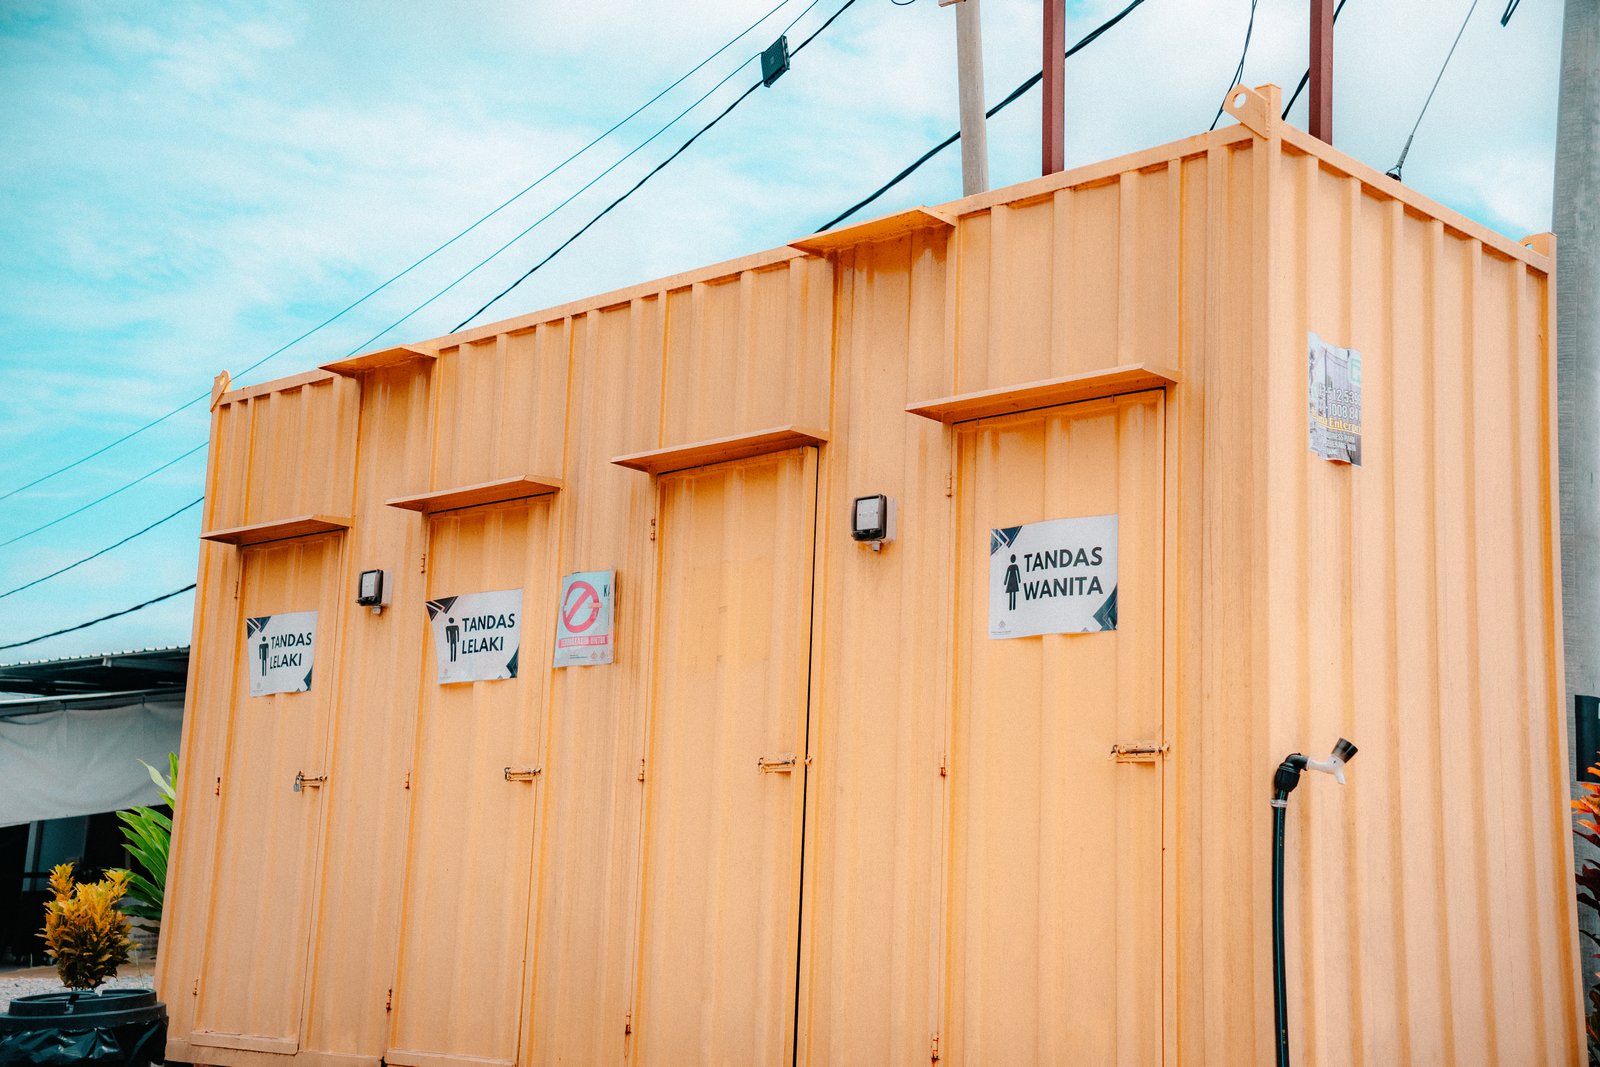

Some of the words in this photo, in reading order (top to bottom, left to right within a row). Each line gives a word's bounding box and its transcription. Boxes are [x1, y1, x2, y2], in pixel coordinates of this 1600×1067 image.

[1023, 546, 1103, 573] TANDAS
[1023, 576, 1103, 601] WANITA
[461, 613, 515, 632] TANDAS
[271, 632, 312, 649] TANDAS
[461, 636, 504, 654] LELAKI
[270, 653, 302, 669] LELAKI
